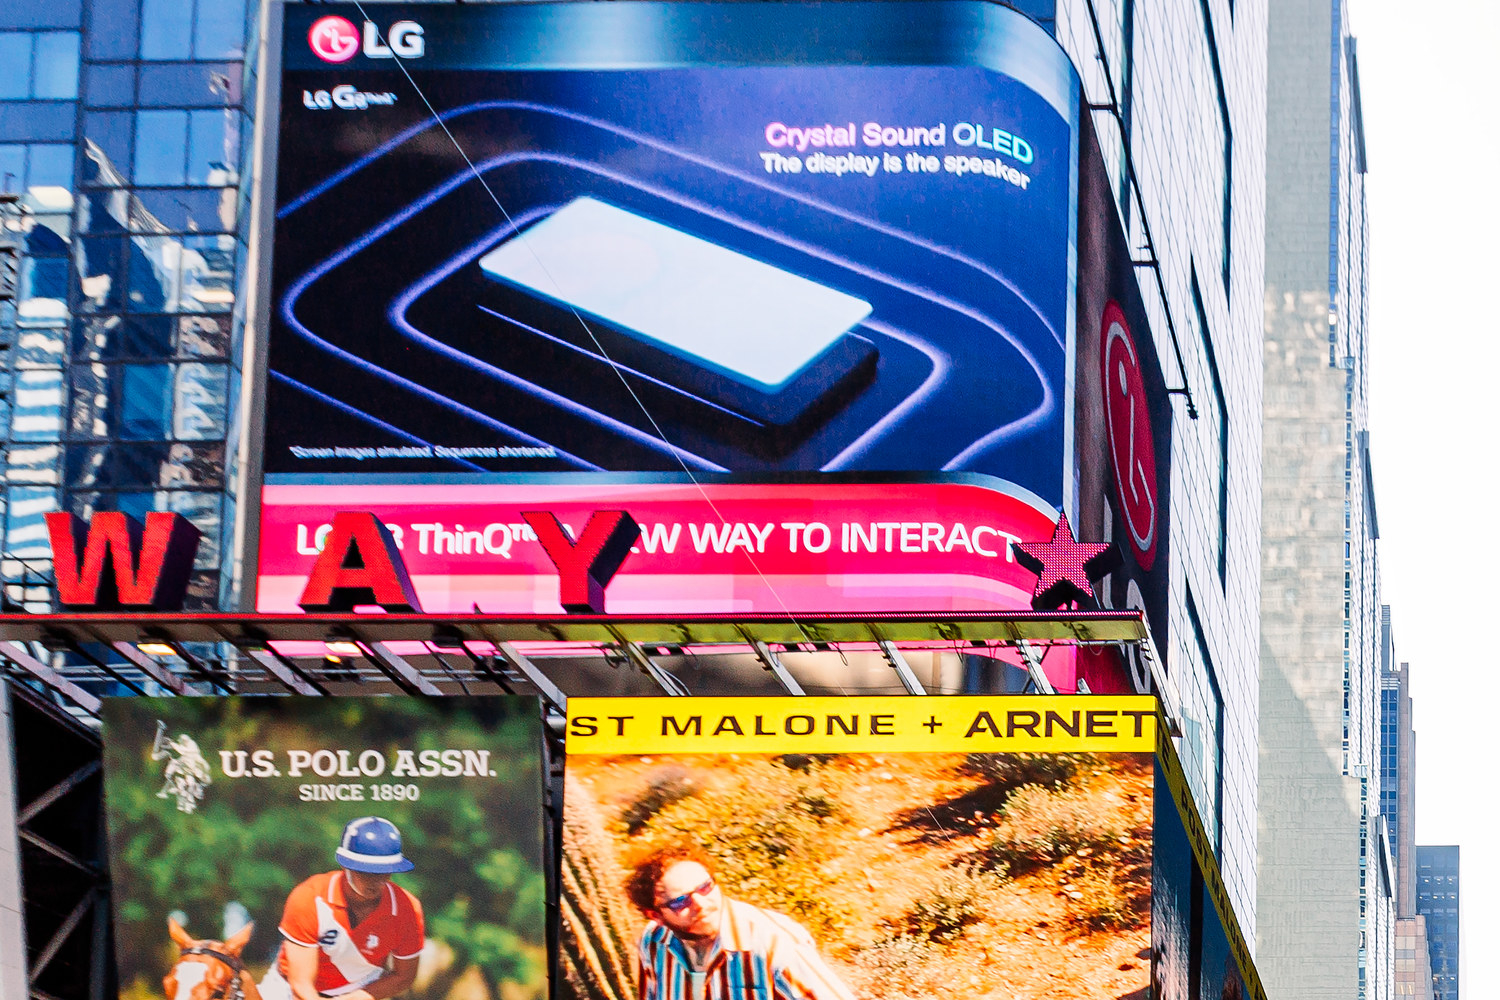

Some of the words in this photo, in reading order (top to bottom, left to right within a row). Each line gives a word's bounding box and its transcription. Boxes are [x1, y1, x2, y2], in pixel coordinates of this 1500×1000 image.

[363, 20, 425, 58] LG
[765, 122, 856, 152] Crystal
[862, 122, 945, 147] Sound
[952, 122, 1034, 165] OLED
[760, 152, 802, 174] The
[806, 152, 879, 177] display
[883, 153, 902, 172] is
[906, 153, 940, 172] the
[944, 153, 1031, 190] speaker
[689, 523, 773, 554] WAY
[781, 523, 832, 554] TO
[841, 523, 1022, 564] INTERACT
[660, 715, 896, 737] MALONE
[219, 751, 280, 777] U.S.
[288, 750, 385, 777] POLO
[395, 750, 497, 778] ASSN.
[299, 784, 363, 802] SINCE
[369, 784, 420, 802] 1890
